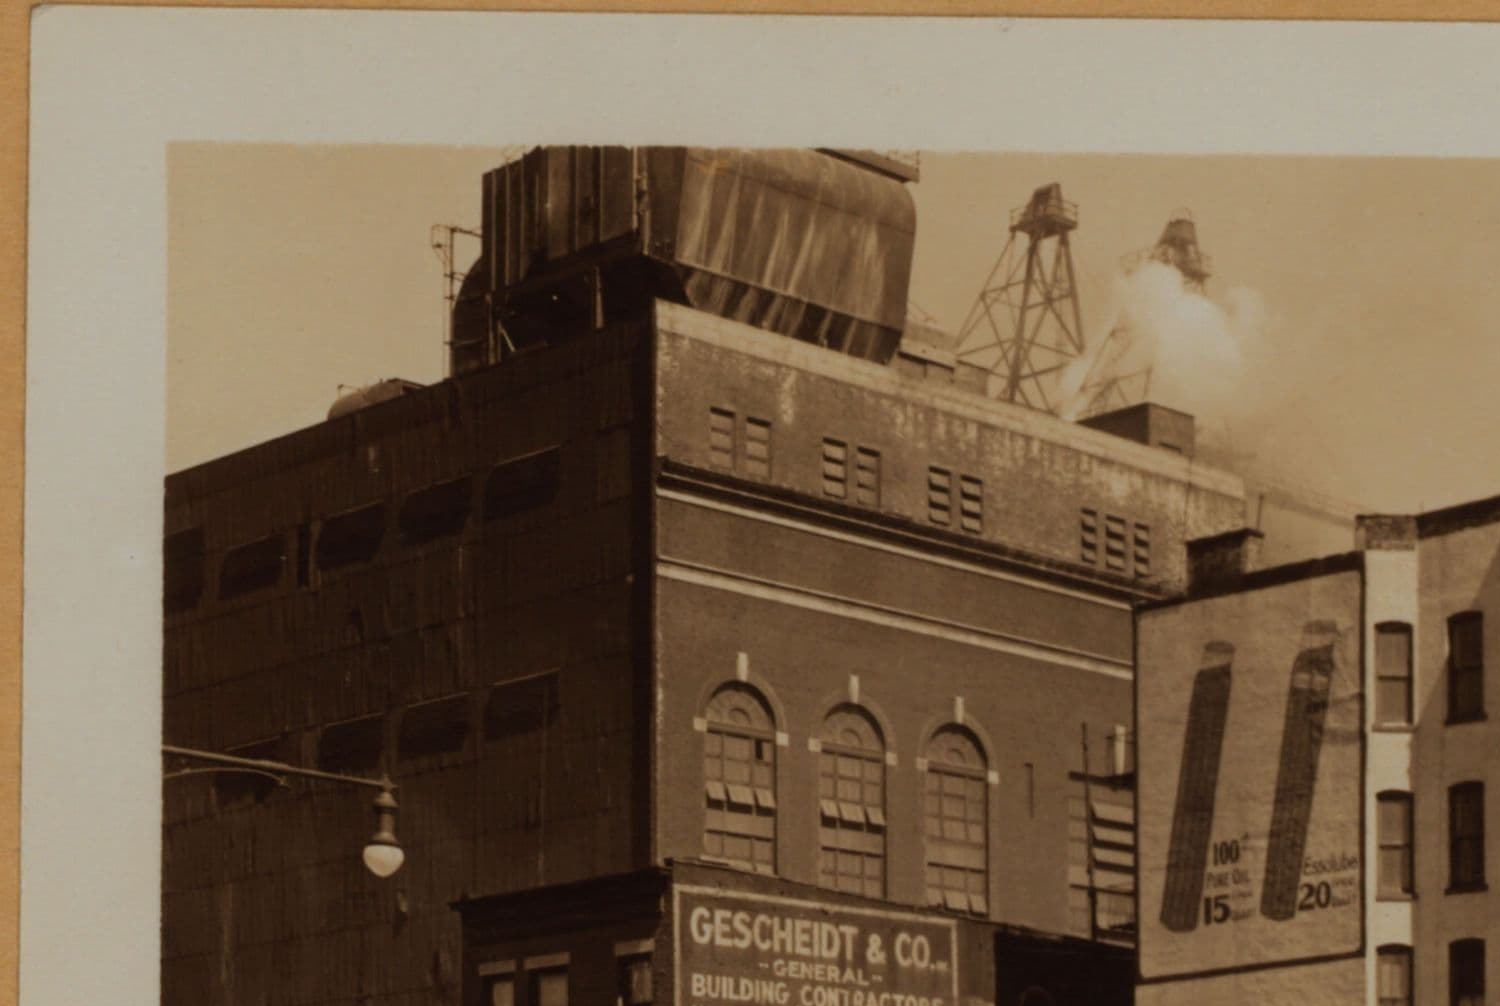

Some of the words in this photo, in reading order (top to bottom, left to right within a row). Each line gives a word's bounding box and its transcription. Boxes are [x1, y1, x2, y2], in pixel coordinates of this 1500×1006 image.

[1204, 894, 1231, 925] 15
[1298, 881, 1331, 911] 20
[690, 906, 858, 961] GESCHEIDT
[866, 934, 887, 965] &
[692, 973, 790, 1004] BUILDING
